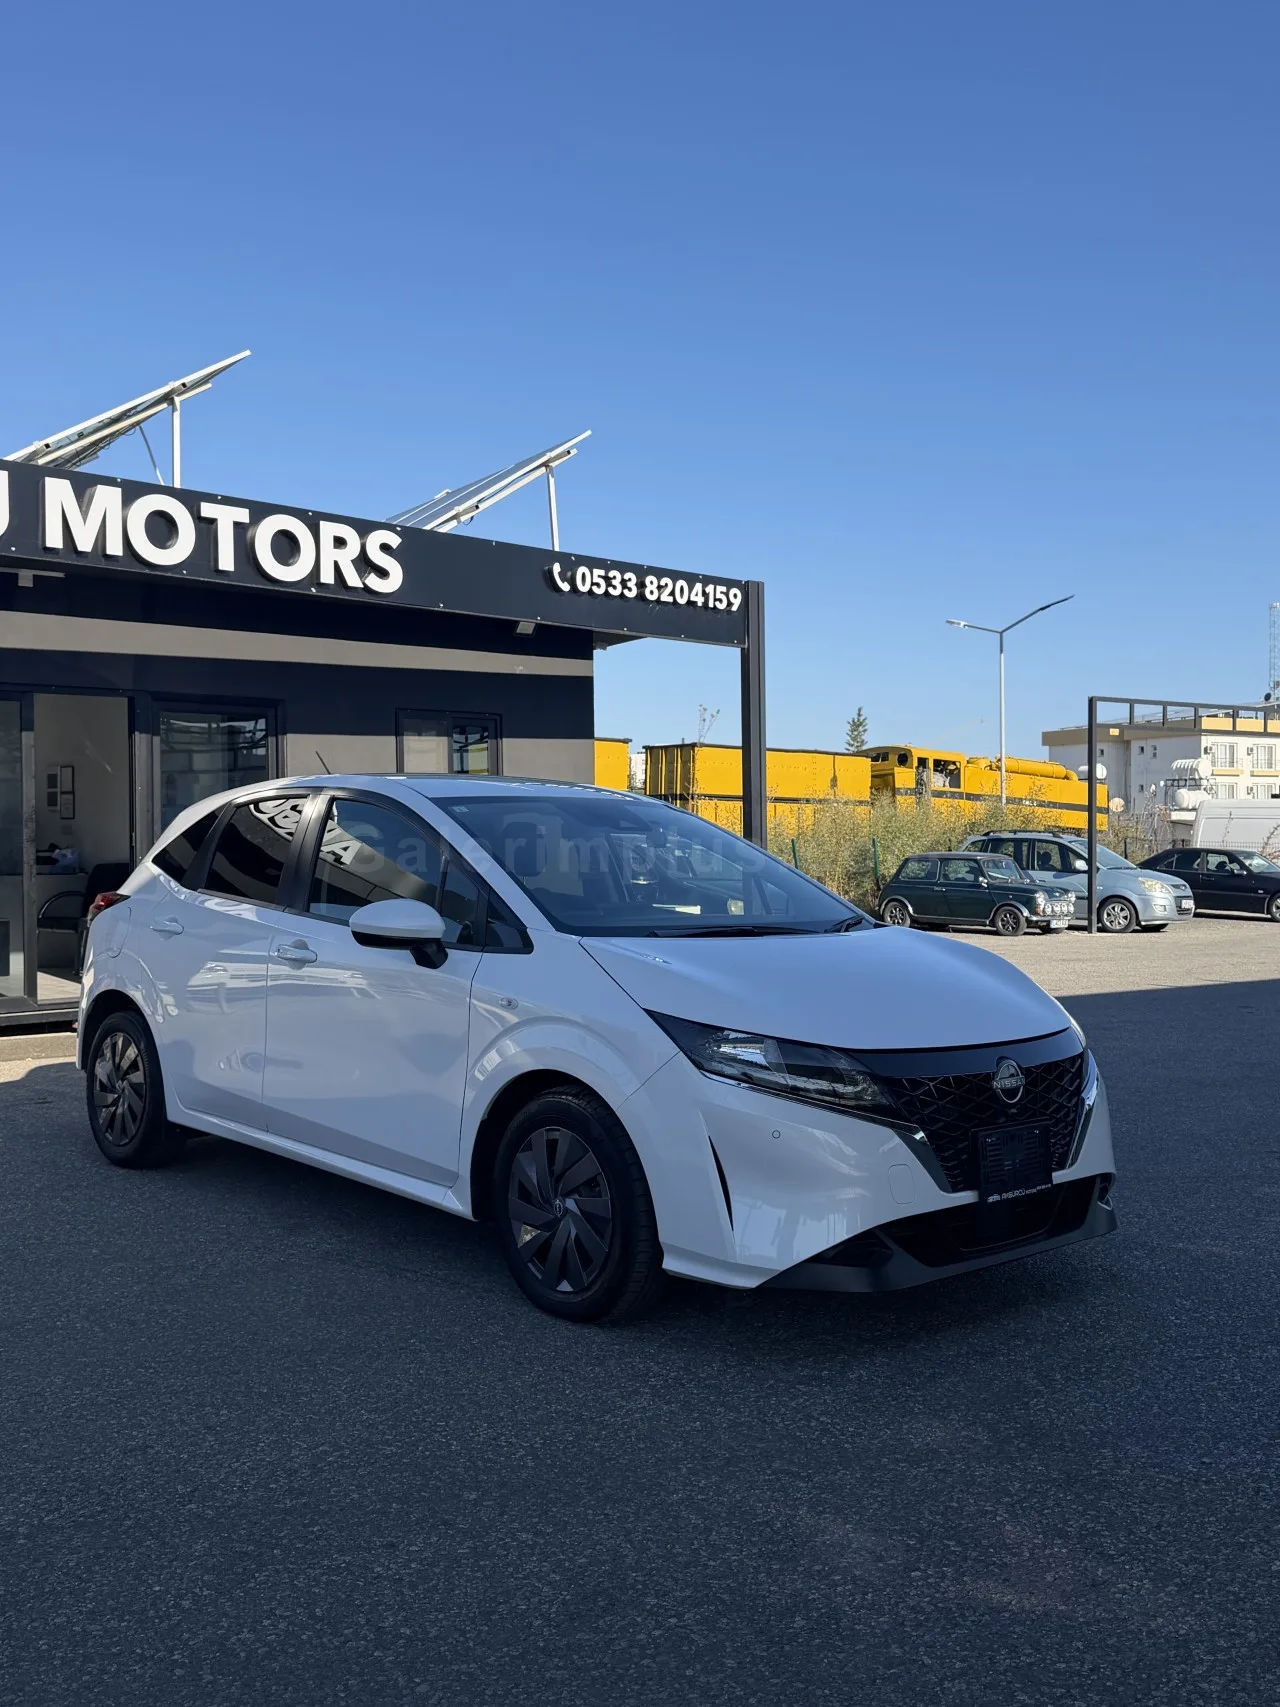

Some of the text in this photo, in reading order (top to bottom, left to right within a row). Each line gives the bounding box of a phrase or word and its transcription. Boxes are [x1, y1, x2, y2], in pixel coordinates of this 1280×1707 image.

[43, 476, 403, 594] MOTORS
[575, 566, 742, 611] 0533 8204159
